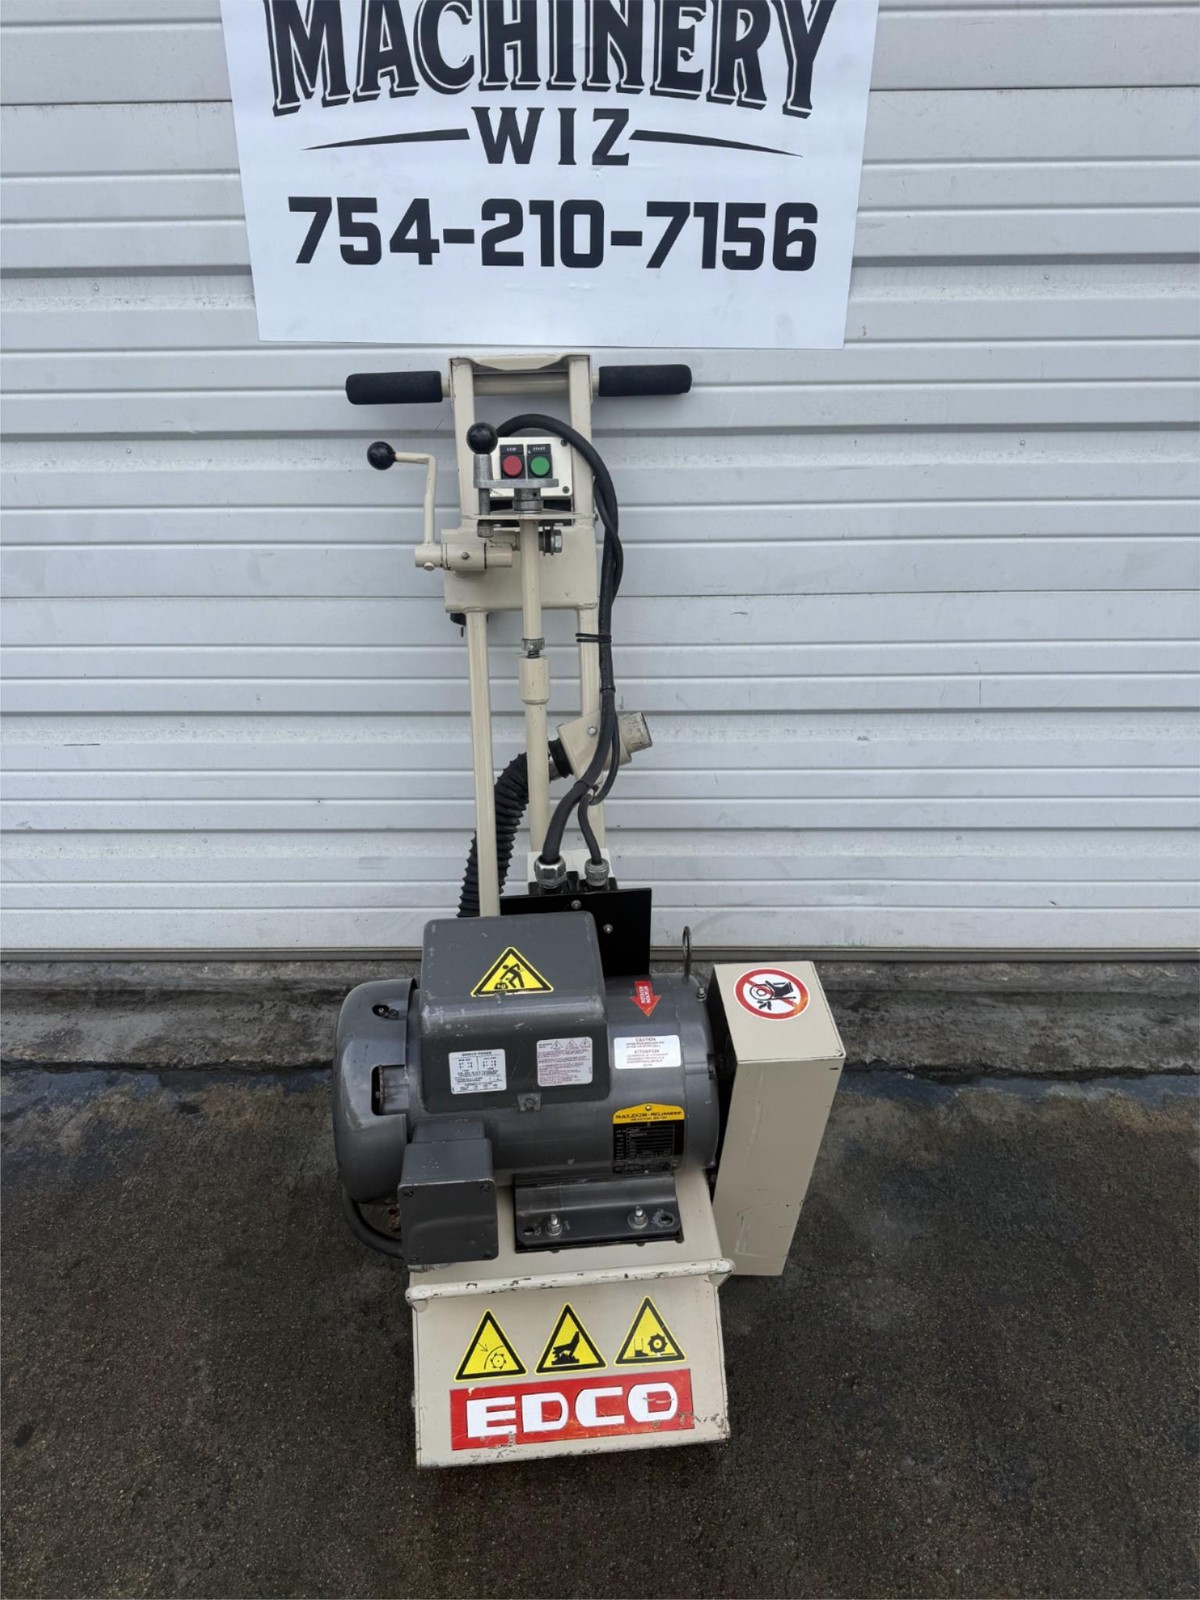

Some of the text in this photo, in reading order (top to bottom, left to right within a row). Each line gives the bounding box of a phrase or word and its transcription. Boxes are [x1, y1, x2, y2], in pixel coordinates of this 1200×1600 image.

[264, 0, 837, 118] MACHINERY
[471, 106, 630, 166] WIZ
[288, 196, 819, 272] 754-210-7156
[466, 1382, 679, 1438] EDCO
